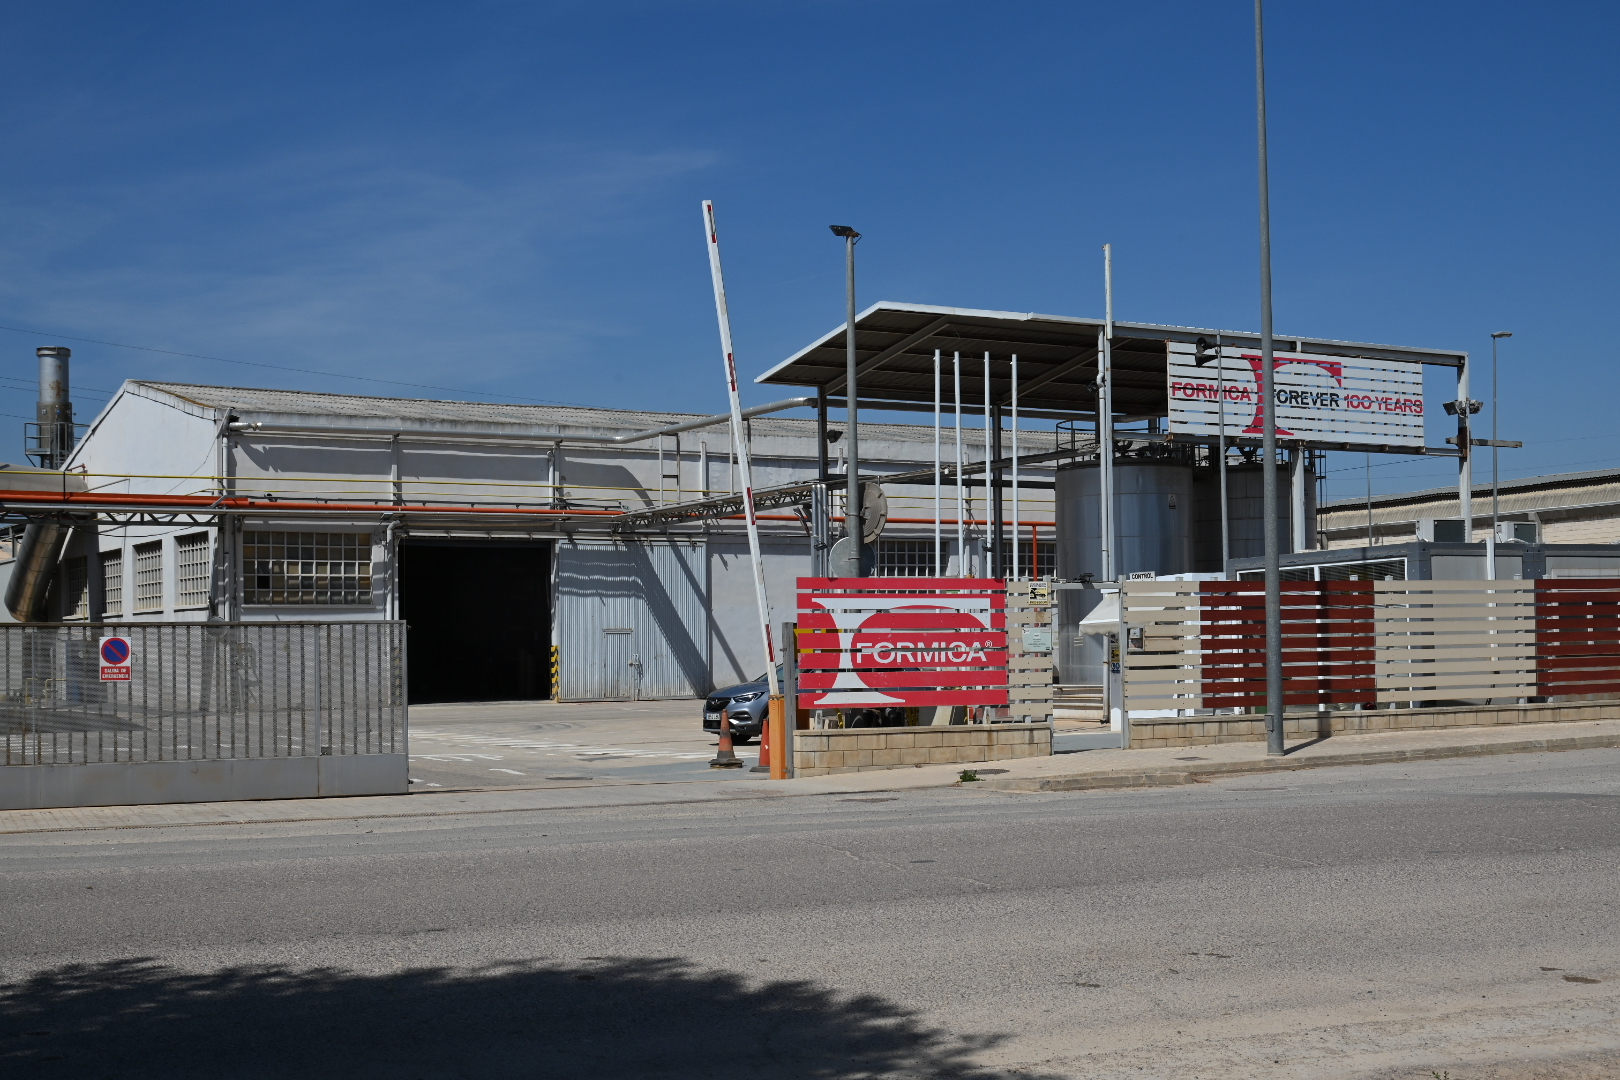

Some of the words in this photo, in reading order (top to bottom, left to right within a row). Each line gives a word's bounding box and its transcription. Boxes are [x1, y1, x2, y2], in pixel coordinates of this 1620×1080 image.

[1171, 381, 1252, 402] FORMICA
[1274, 388, 1340, 408] OREVER
[1344, 393, 1373, 410] 100
[1375, 395, 1424, 414] YEARS
[1131, 572, 1154, 580] CONTROL
